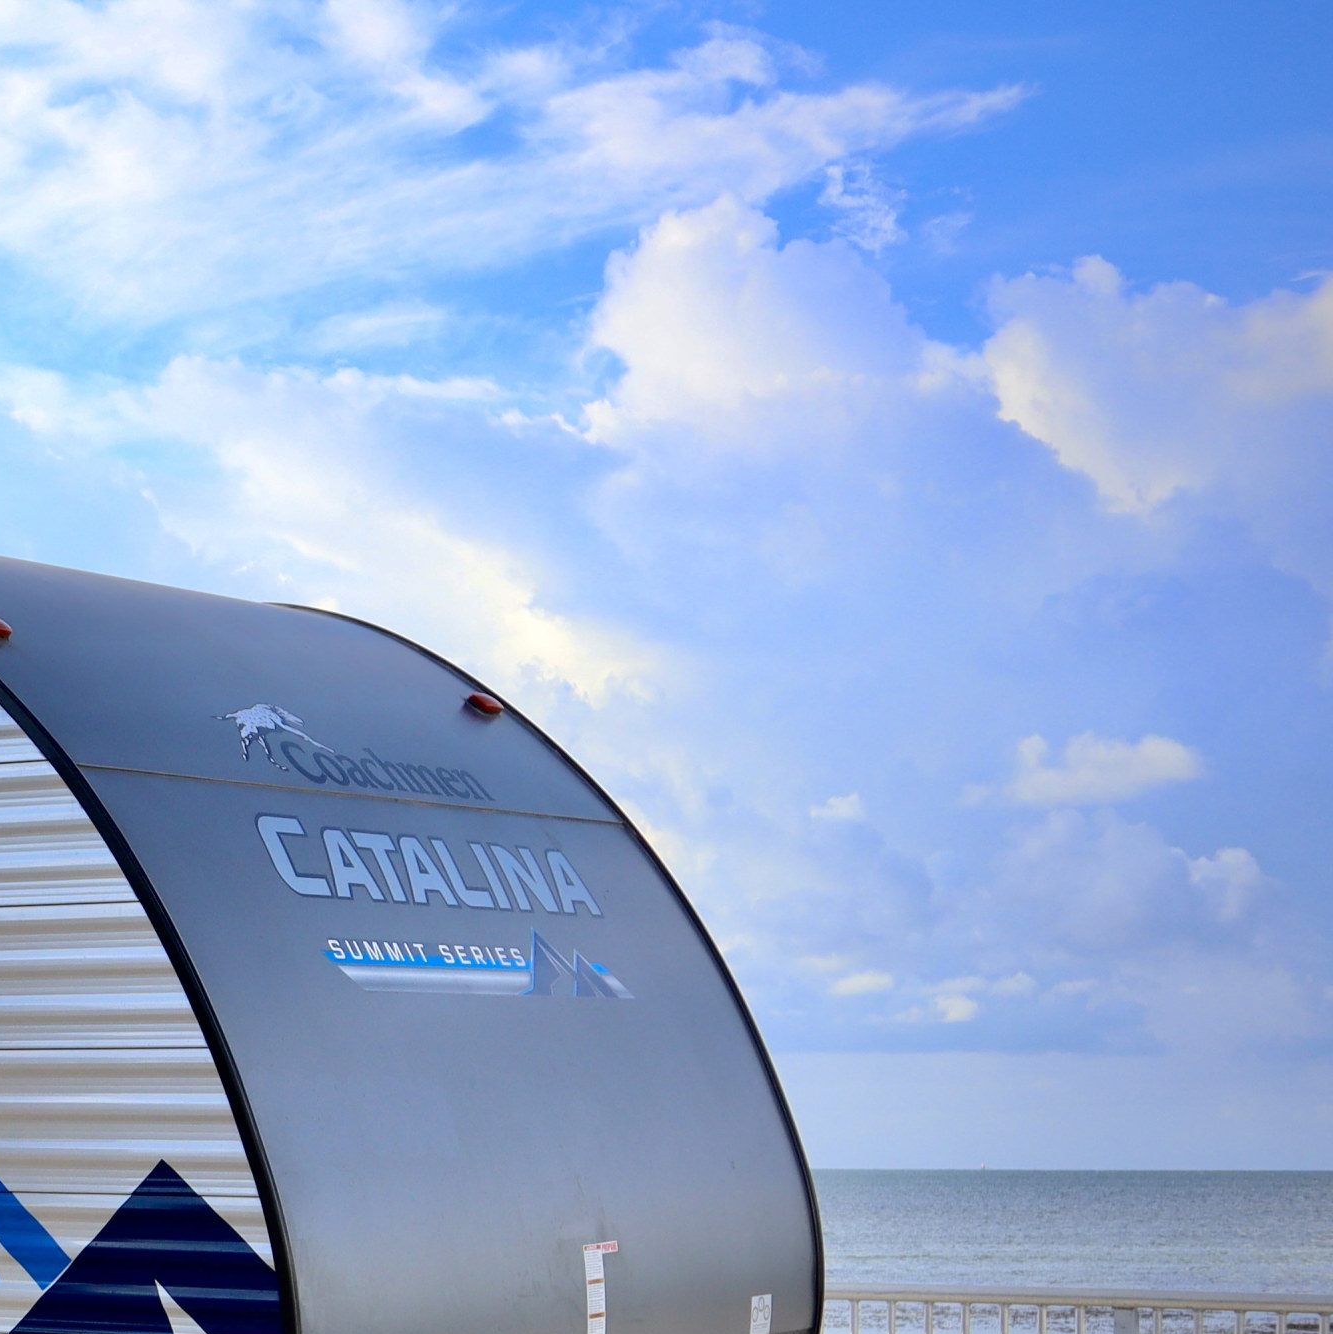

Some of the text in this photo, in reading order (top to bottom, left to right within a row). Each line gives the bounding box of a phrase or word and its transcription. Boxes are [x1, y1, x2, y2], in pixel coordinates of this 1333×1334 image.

[280, 741, 495, 801] Coachmen
[254, 812, 603, 918] CATALINA
[327, 939, 527, 967] SUMMIT SERIES
